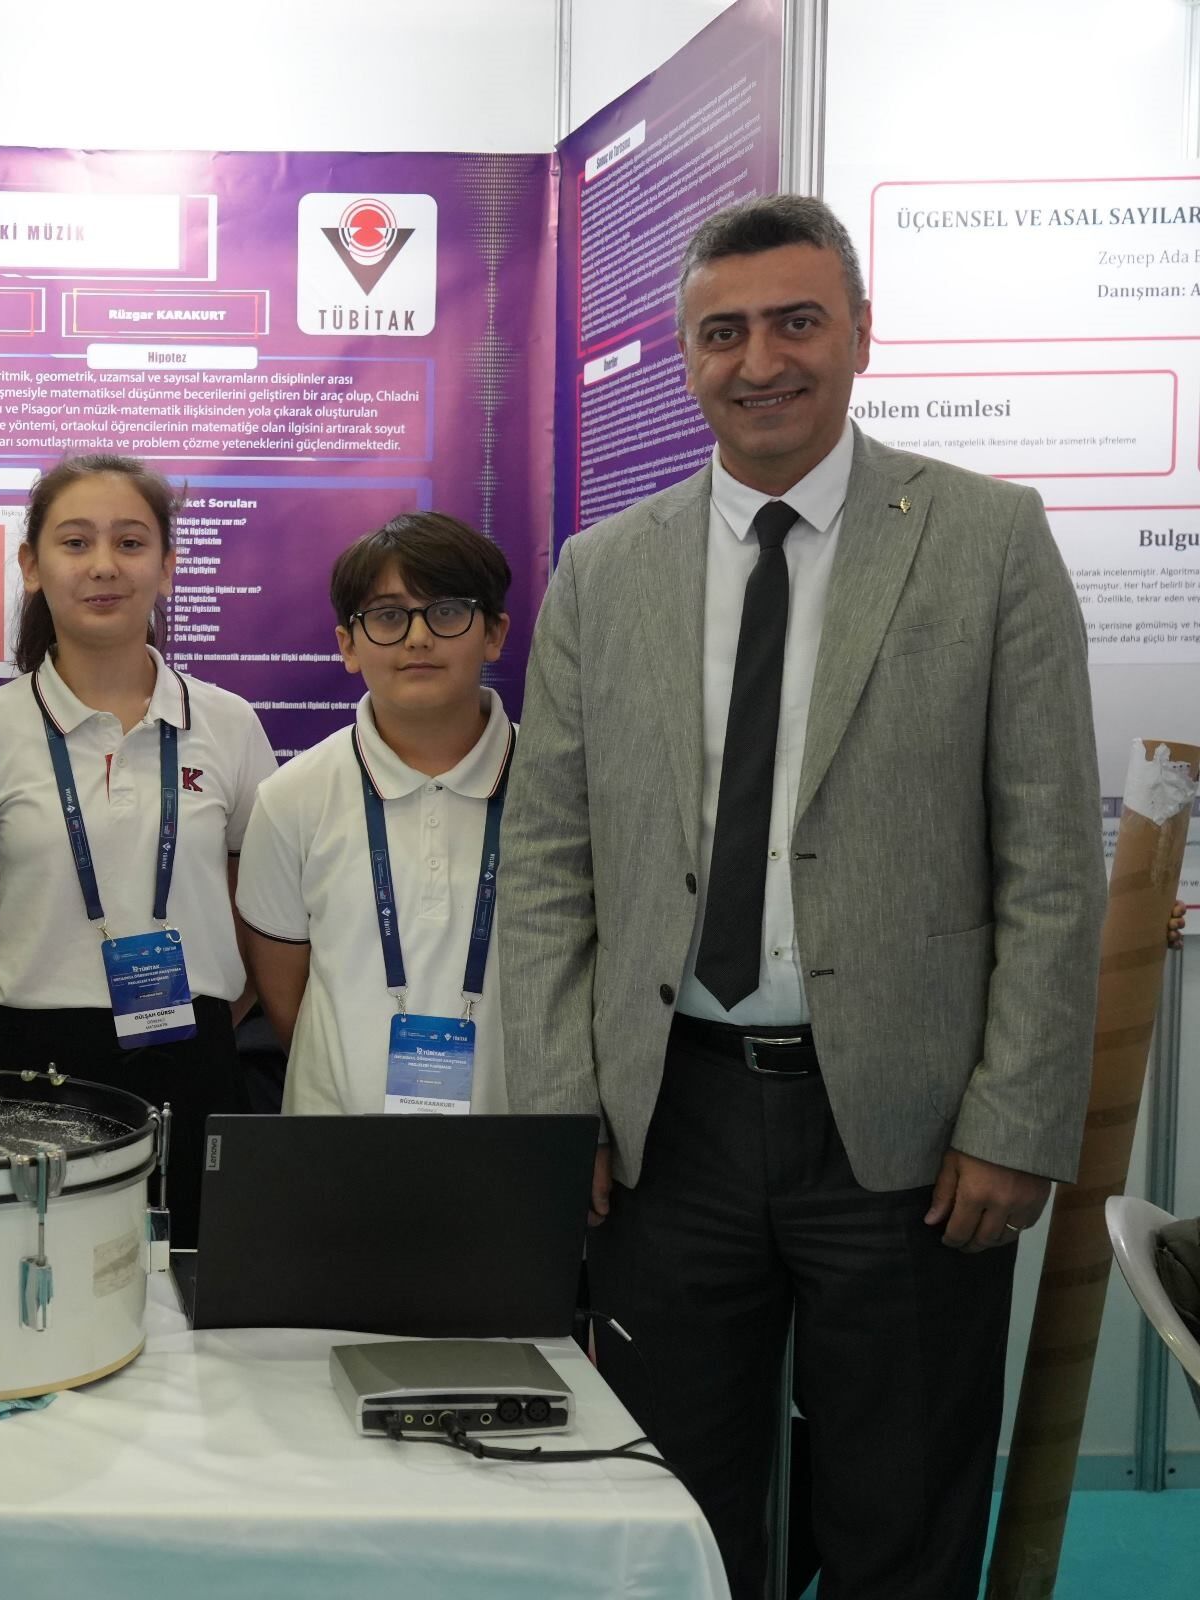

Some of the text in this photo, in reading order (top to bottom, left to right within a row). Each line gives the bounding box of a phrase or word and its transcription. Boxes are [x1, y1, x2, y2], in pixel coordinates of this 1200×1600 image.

[897, 206, 1200, 232] ÜÇGENSEL VE ASAL SAYILAR
[27, 222, 85, 241] MÜZİK
[1098, 249, 1189, 267] Zeynep Ada
[1097, 283, 1186, 300] Danışman:
[108, 308, 226, 322] Rüzgar KARAKURT
[318, 307, 416, 332] TÜBİTAK
[147, 351, 187, 364] Hipotez
[35, 370, 96, 384] geometrik,
[99, 371, 145, 382] uzamsal
[147, 374, 161, 382] ve
[163, 371, 200, 385] sayısal
[202, 372, 268, 383] kavramların
[270, 372, 326, 386] disiplinler
[327, 375, 353, 384] arası
[50, 387, 125, 398] matematiksel
[127, 388, 181, 401] düşünme
[183, 388, 246, 399] becerilerini
[248, 388, 300, 402] geliştiren
[302, 388, 319, 400] bir
[320, 392, 343, 404] araç
[345, 389, 374, 403] olup,
[375, 390, 419, 401] Chladni
[4, 405, 18, 413] ve
[83, 404, 181, 415] müzik-matematik
[183, 404, 245, 417] ilişkisinden
[247, 405, 271, 418] yola
[273, 405, 312, 418] çıkarak
[314, 406, 378, 419] oluşturulan
[849, 399, 1011, 419] oblem Cümlesi
[8, 419, 58, 432] yöntemi,
[60, 420, 108, 431] ortaokul
[110, 420, 188, 433] öğrencilerinin
[191, 421, 259, 434] matematiğe
[261, 421, 285, 432] olan
[288, 421, 323, 435] ilgisini
[325, 422, 372, 433] artırarak
[374, 424, 405, 436] soyut
[15, 436, 113, 448] somutlaştırmakta
[115, 439, 129, 447] ve
[132, 437, 180, 450] problem
[182, 437, 219, 450] çözme
[221, 437, 294, 450] yeteneklerini
[295, 438, 400, 451] güçlendirmektedir.
[208, 498, 257, 508] Soruları
[1139, 528, 1200, 551] Bulgu
[181, 767, 203, 792] K
[208, 1138, 218, 1168] Lenovo
